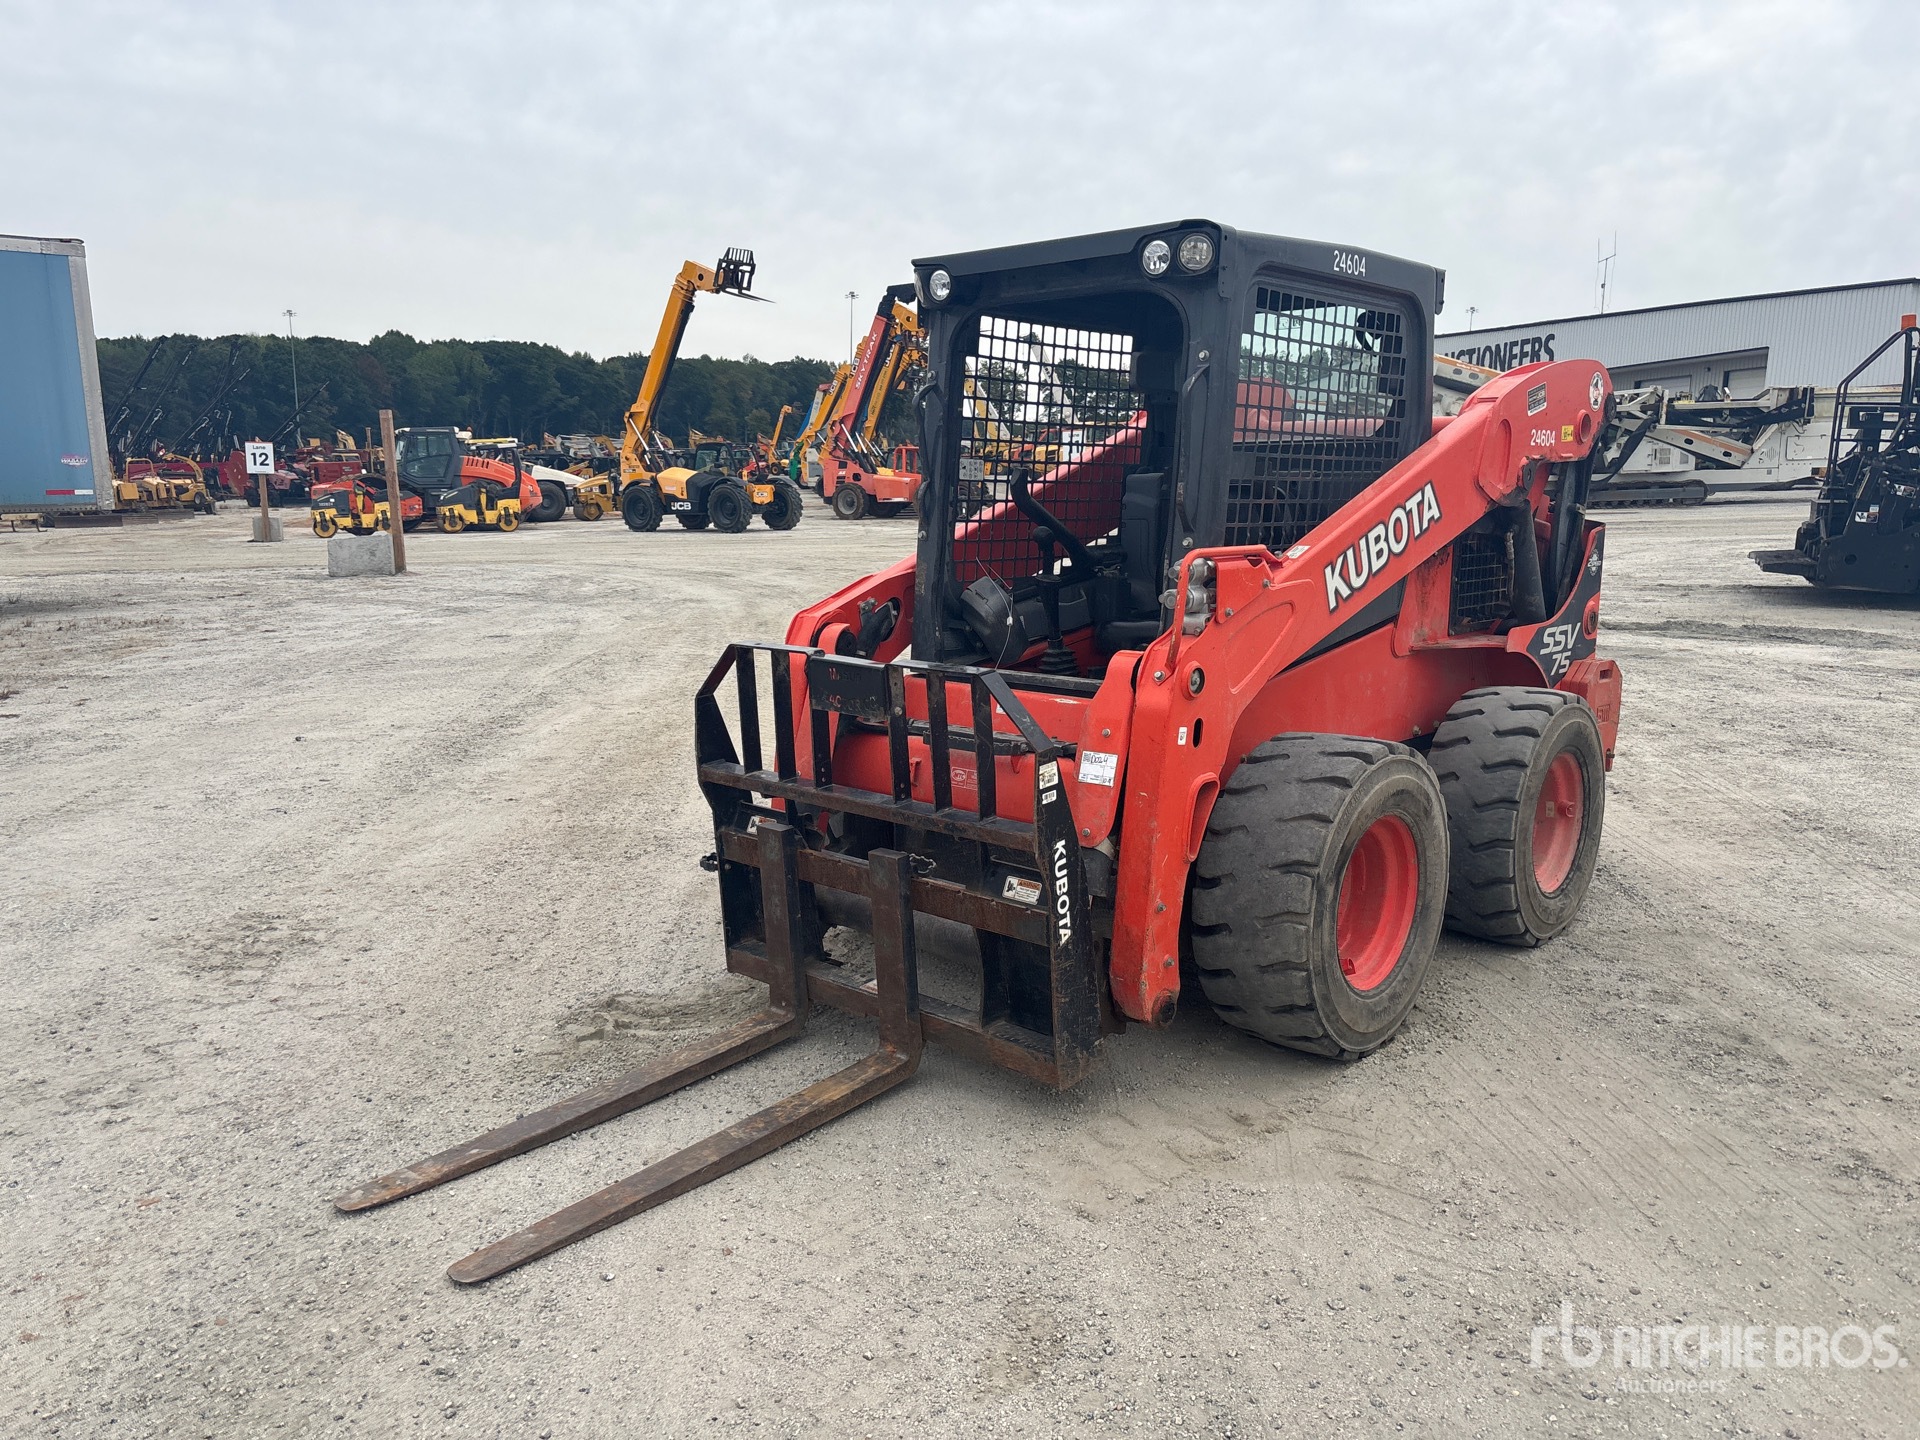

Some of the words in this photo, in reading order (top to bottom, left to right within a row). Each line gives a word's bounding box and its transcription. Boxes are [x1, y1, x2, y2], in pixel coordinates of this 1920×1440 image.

[1333, 249, 1366, 277] 24604
[855, 331, 877, 390] SKYTRAK
[1444, 334, 1555, 373] TIONEERS
[849, 357, 861, 379] JCB
[828, 379, 839, 396] JCB
[1530, 428, 1556, 447] 24604
[250, 452, 270, 467] 12
[671, 501, 692, 511] JCB
[1323, 481, 1442, 613] KUBOTA
[1539, 621, 1582, 656] SSV
[1550, 650, 1572, 677] 75
[1053, 838, 1072, 947] KUBOTA
